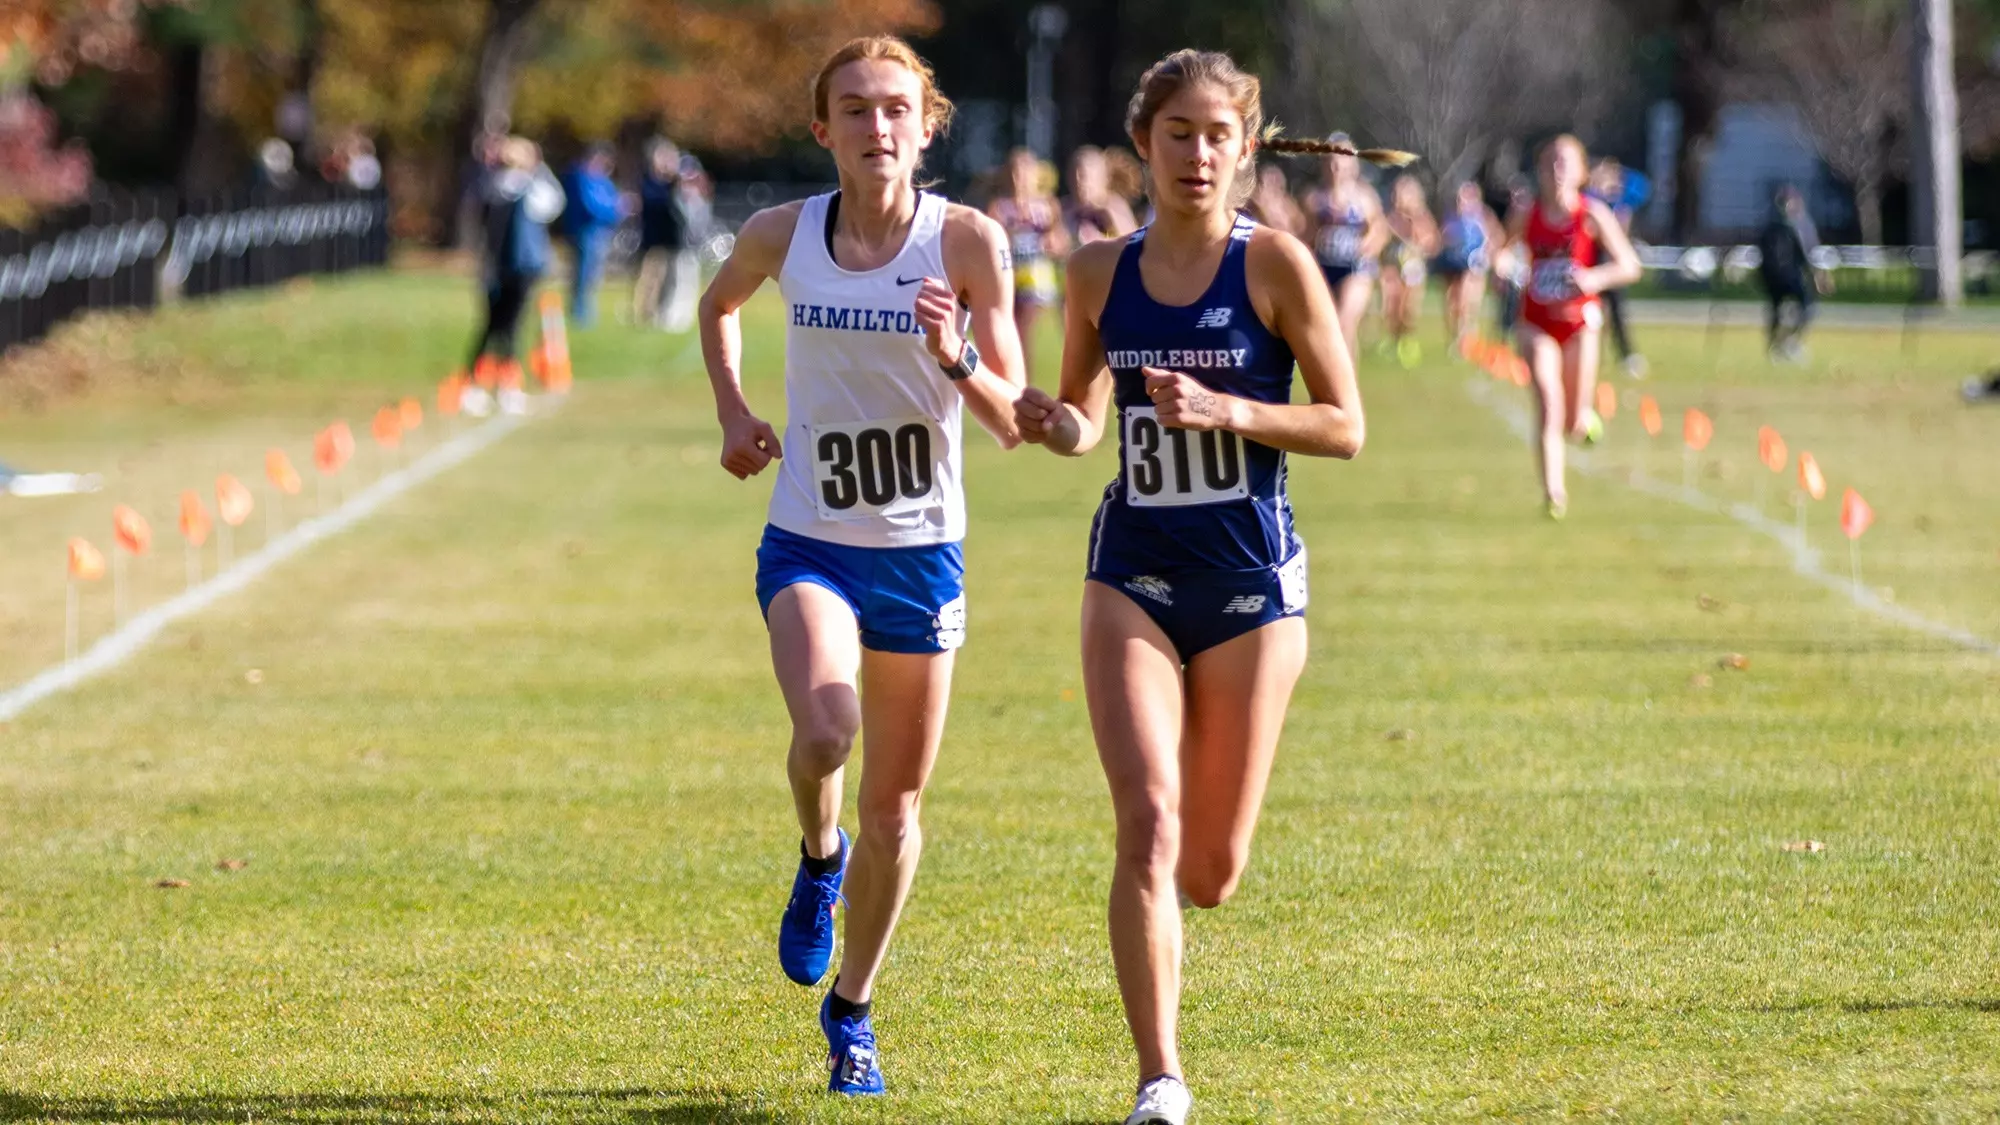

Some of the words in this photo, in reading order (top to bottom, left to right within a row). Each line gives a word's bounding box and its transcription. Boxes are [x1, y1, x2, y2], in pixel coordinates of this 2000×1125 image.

[1107, 349, 1247, 369] MIDDLEBURY
[817, 423, 932, 510] 300
[1131, 416, 1240, 496] 310
